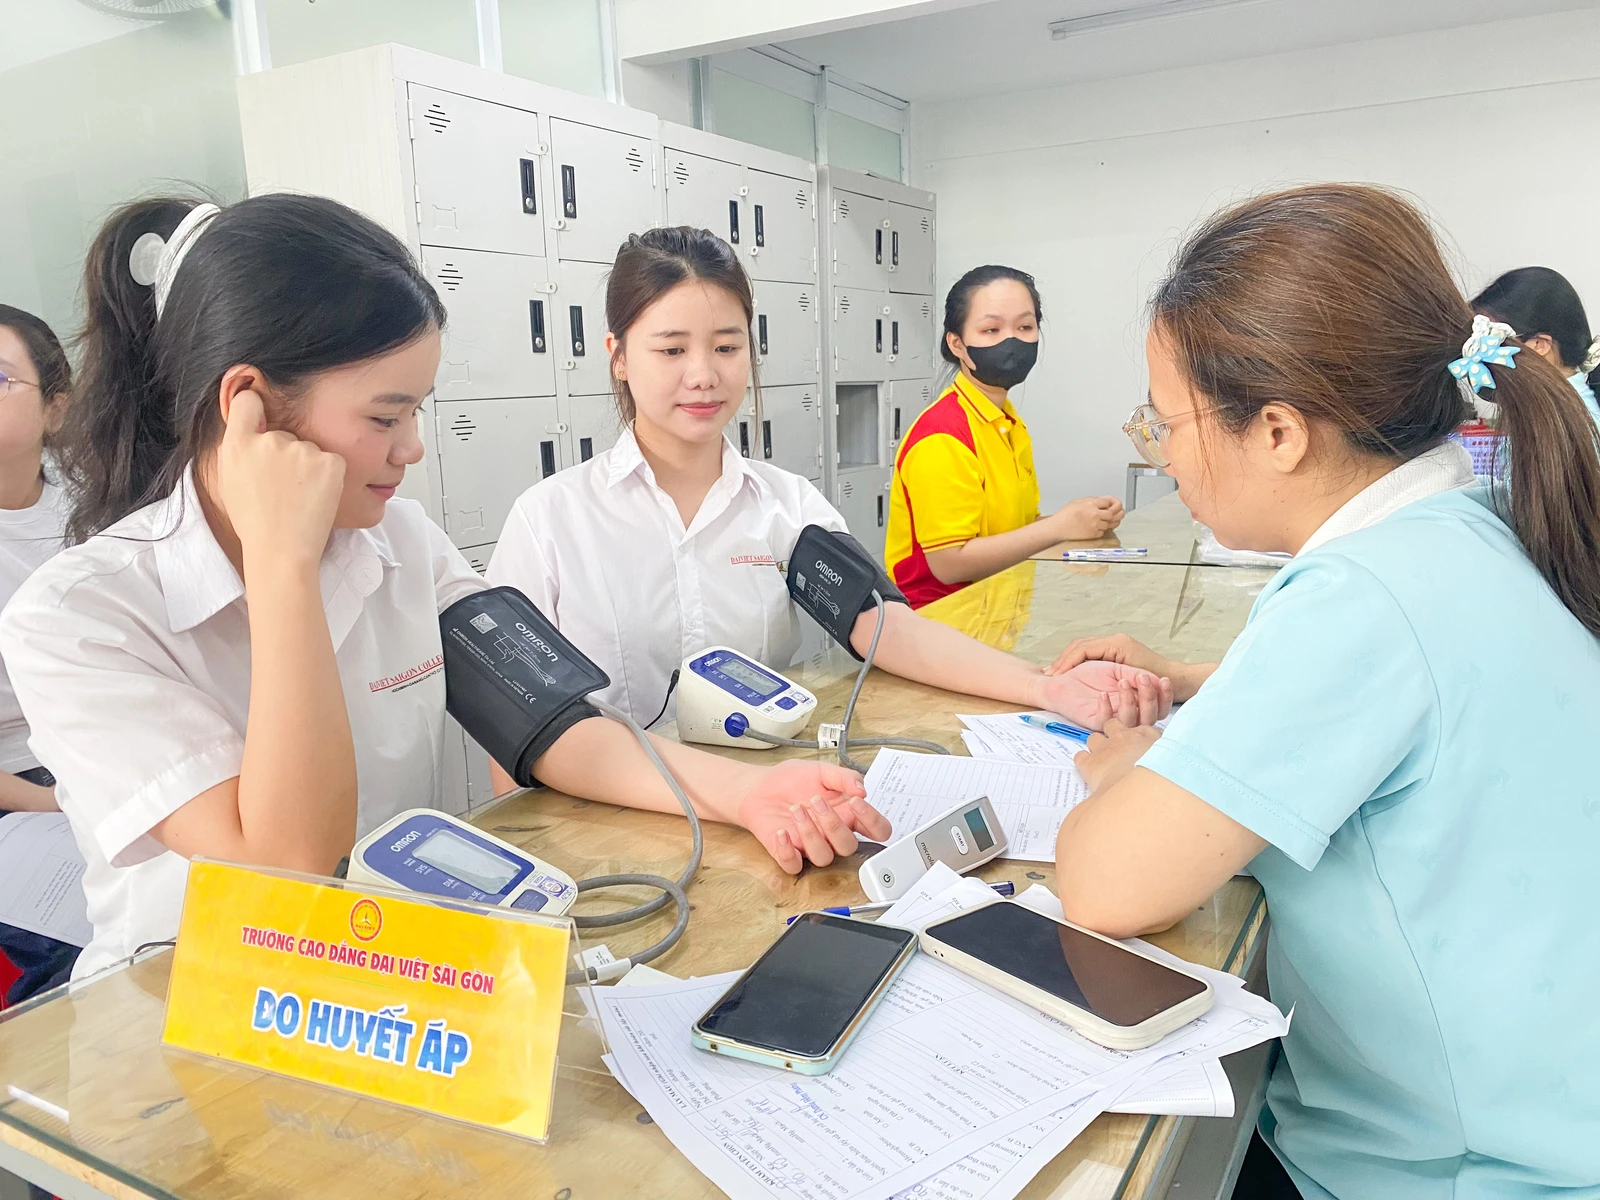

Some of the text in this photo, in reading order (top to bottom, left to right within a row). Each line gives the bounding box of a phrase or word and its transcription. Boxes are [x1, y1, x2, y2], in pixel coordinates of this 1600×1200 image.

[815, 560, 843, 587] OMRON
[515, 622, 559, 662] OMRON
[390, 668, 418, 683] SAIGON
[390, 830, 422, 852] OMRON
[956, 832, 965, 847] START
[920, 842, 934, 867] microli
[415, 864, 428, 874] SYS
[443, 878, 456, 888] DIA
[466, 890, 480, 901] LSE
[242, 926, 495, 995] TRƯỜNG CAO ĐẲNG ĐẠI VIỆT SÀI GÒN
[253, 989, 468, 1075] ĐO HUYẾT ÁP
[988, 1140, 1018, 1156] Hemogl
[1013, 1140, 1027, 1148] VG
[721, 1142, 777, 1185] KHÁM TUYỂN CHỌN
[975, 1172, 991, 1181] Giờ
[957, 1188, 974, 1198] Giờ
